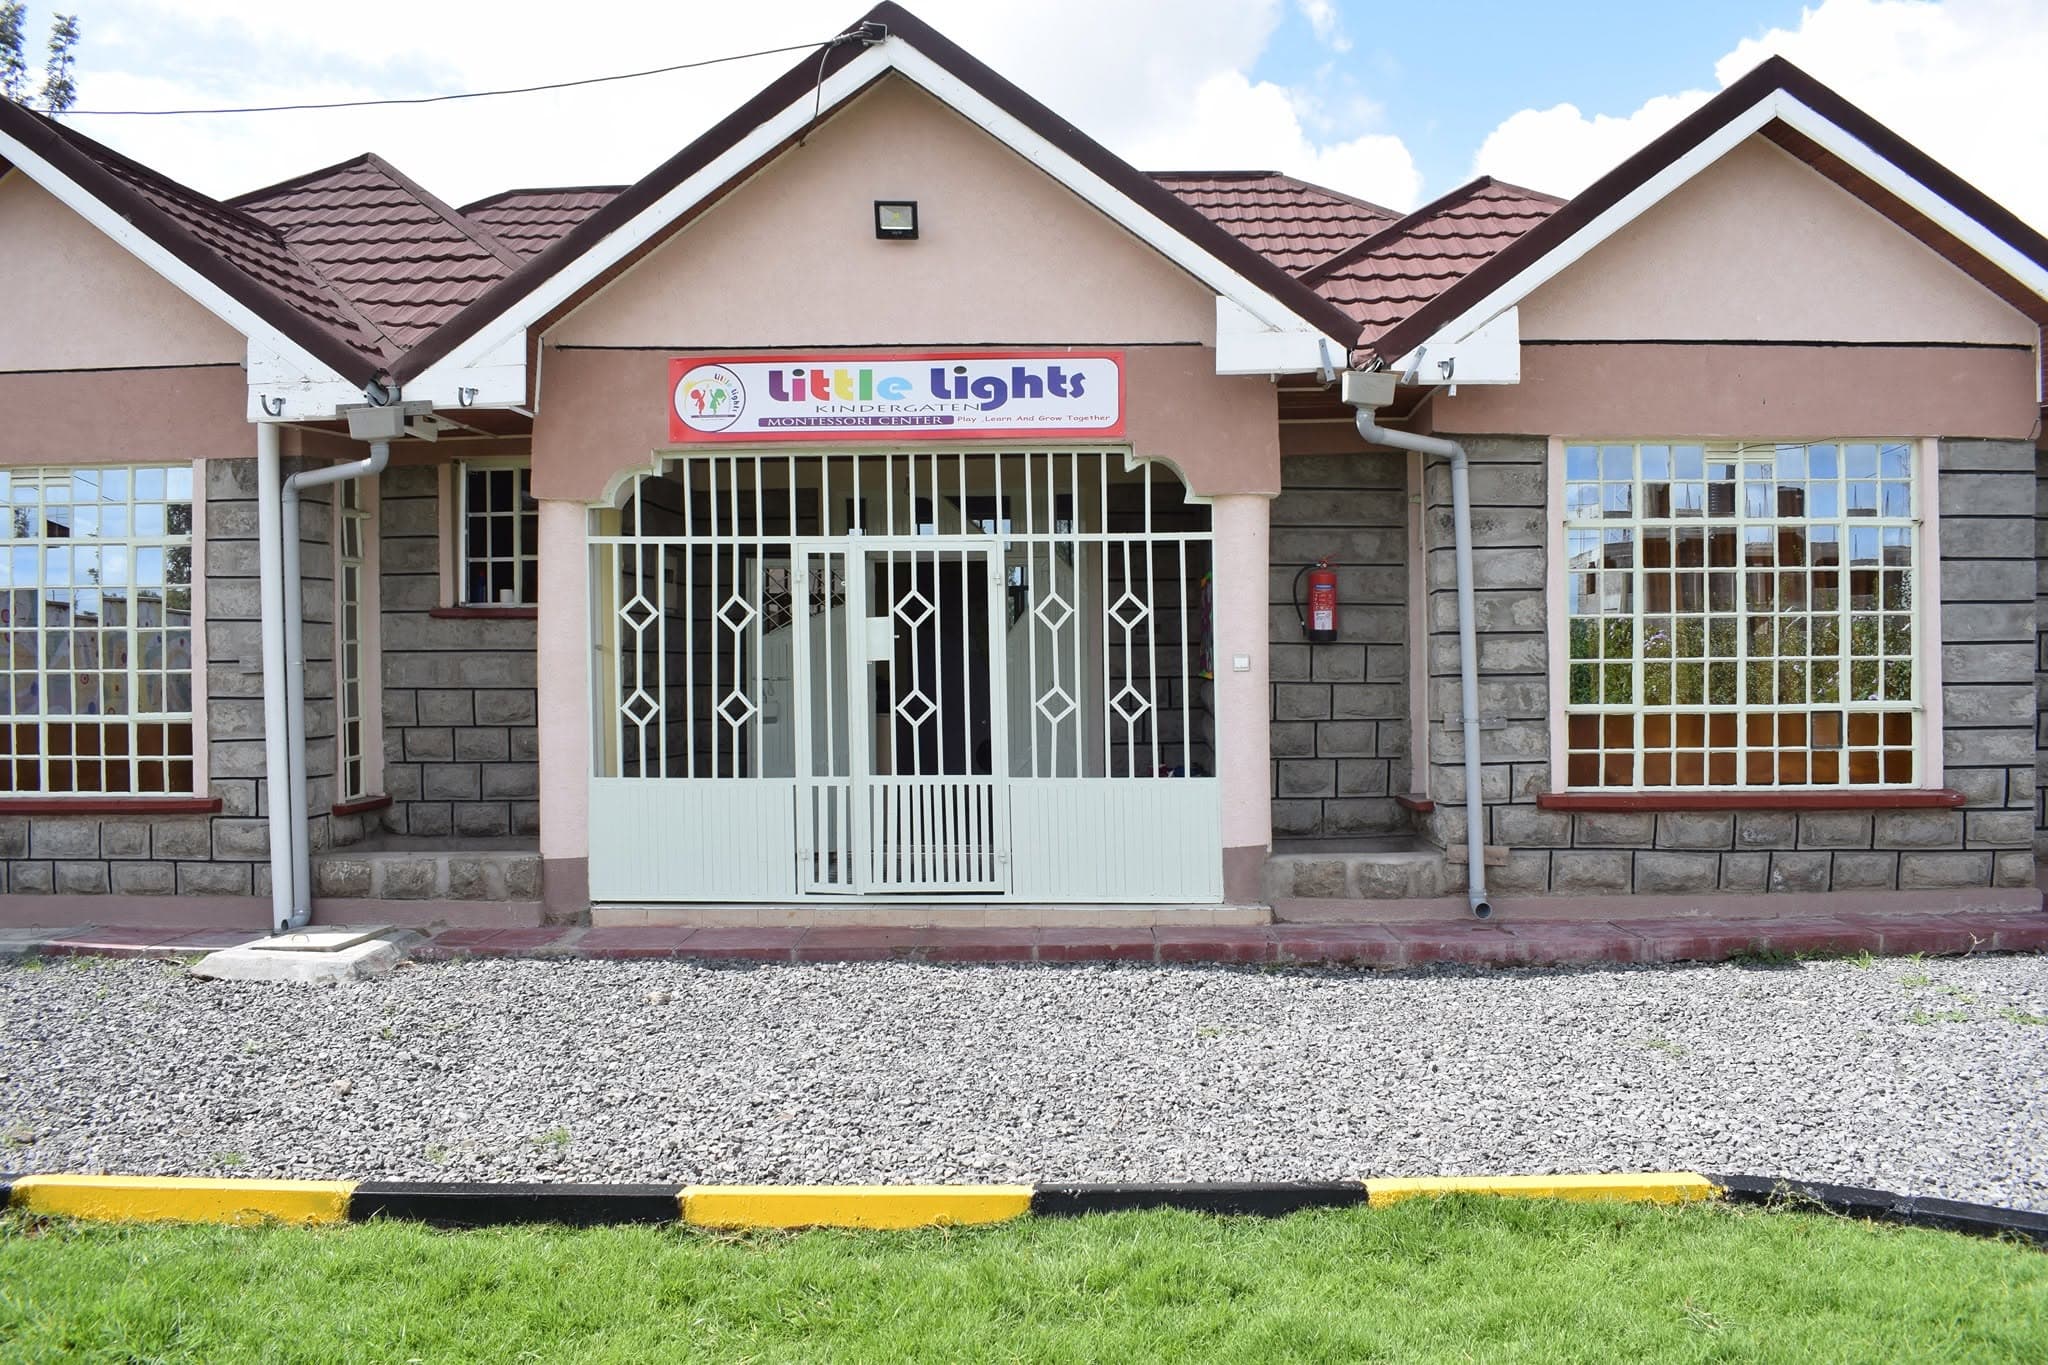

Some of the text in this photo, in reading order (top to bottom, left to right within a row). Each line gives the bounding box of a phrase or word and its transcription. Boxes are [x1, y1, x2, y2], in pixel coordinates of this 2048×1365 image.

[768, 365, 1086, 412] Little Lights
[815, 403, 980, 413] KINDERGATEN
[767, 415, 943, 427] MONTESSORI CENTER
[1067, 414, 1111, 423] Together
